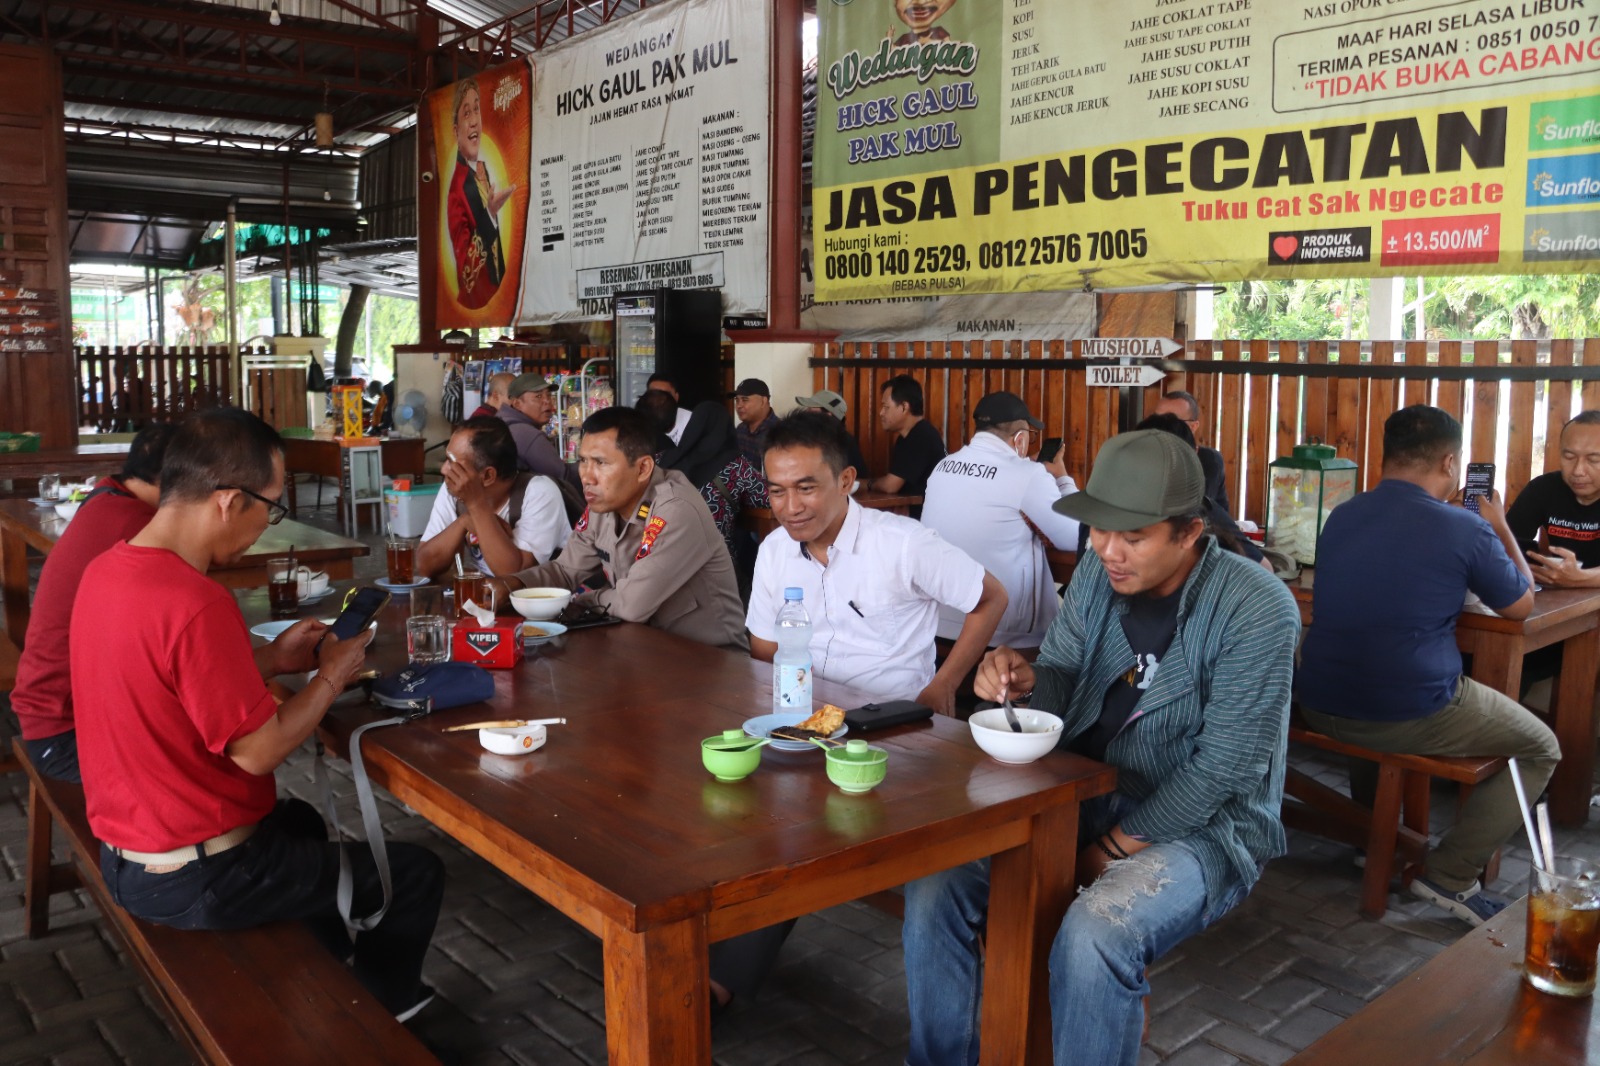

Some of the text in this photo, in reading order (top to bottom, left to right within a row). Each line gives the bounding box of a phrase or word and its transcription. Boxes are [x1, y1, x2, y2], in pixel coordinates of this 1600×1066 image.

[1013, 10, 1034, 25] KOPI
[1130, 0, 1252, 32] JAHE COKLAT TAPE
[1304, 3, 1336, 20] NASI
[1012, 27, 1035, 43] SUSU
[1124, 17, 1252, 49] JAHE SUSU TAPE COKLAT
[1337, 28, 1384, 50] MAAF
[1389, 20, 1432, 40] HARI
[1438, 6, 1515, 33] SELASA
[1012, 43, 1040, 59] JERUK
[1141, 35, 1251, 64] JAHE SUSU PUTIH
[1298, 55, 1363, 78] TERIMA
[1368, 37, 1458, 68] PESANAN
[1477, 28, 1522, 50] 0851
[1530, 19, 1580, 41] 0050
[829, 38, 979, 97] Wedangan
[1011, 62, 1106, 91] JAHE GEPUK GULA BATU
[1012, 56, 1060, 76] TEH TARIK
[1128, 56, 1250, 84] JAHE SUSU COKLAT
[1396, 58, 1470, 88] BUKA
[556, 83, 595, 117] HICK
[599, 69, 646, 103] GAUL
[652, 53, 686, 88] PAK
[692, 39, 738, 74] MUL
[1147, 76, 1250, 100] JAHE KOPI SUSU
[837, 82, 977, 130] HICK GAUL
[1010, 85, 1074, 108] JAHE KENCUR
[1158, 96, 1249, 118] JAHE SECANG
[589, 96, 662, 126] JAJAN HEMAT RASA
[703, 110, 735, 125] MAKANAN
[1010, 96, 1109, 125] JAHE KENCUR JERUK
[702, 125, 743, 141] NASI BANDENG
[849, 121, 961, 163] PAK MUL
[702, 141, 715, 151] NASI
[717, 138, 734, 149] OSENG
[702, 148, 744, 162] NASI TUMPANG
[702, 158, 749, 173] BUBUR TUMPANG
[824, 106, 1507, 232] JASA PENGECATAN
[702, 173, 716, 184] NASI
[702, 186, 716, 195] NASI
[702, 193, 751, 206] BUBUR TUMPANG
[1183, 182, 1504, 222] Tuku Cat Sak Ngecate
[824, 235, 871, 253] Hubungi
[874, 231, 901, 247] kami
[1302, 233, 1352, 247] PRODUK
[825, 252, 872, 280] 0800
[876, 249, 910, 276] 140
[914, 244, 971, 274] 2529,
[978, 239, 1026, 270] 0812
[1030, 233, 1081, 266] 2576
[1087, 228, 1148, 262] 7005
[1300, 245, 1364, 259] INDONESIA
[600, 264, 639, 285] RESERVASI
[646, 259, 692, 280] PEMESANAN
[892, 276, 966, 293] (BEBAS PULSA)
[957, 319, 1015, 332] MAKANAN
[1082, 339, 1164, 356] MUSHOLA
[1092, 367, 1142, 384] TOILET
[937, 460, 998, 480] INDONESIA
[469, 633, 498, 643] VIPER
